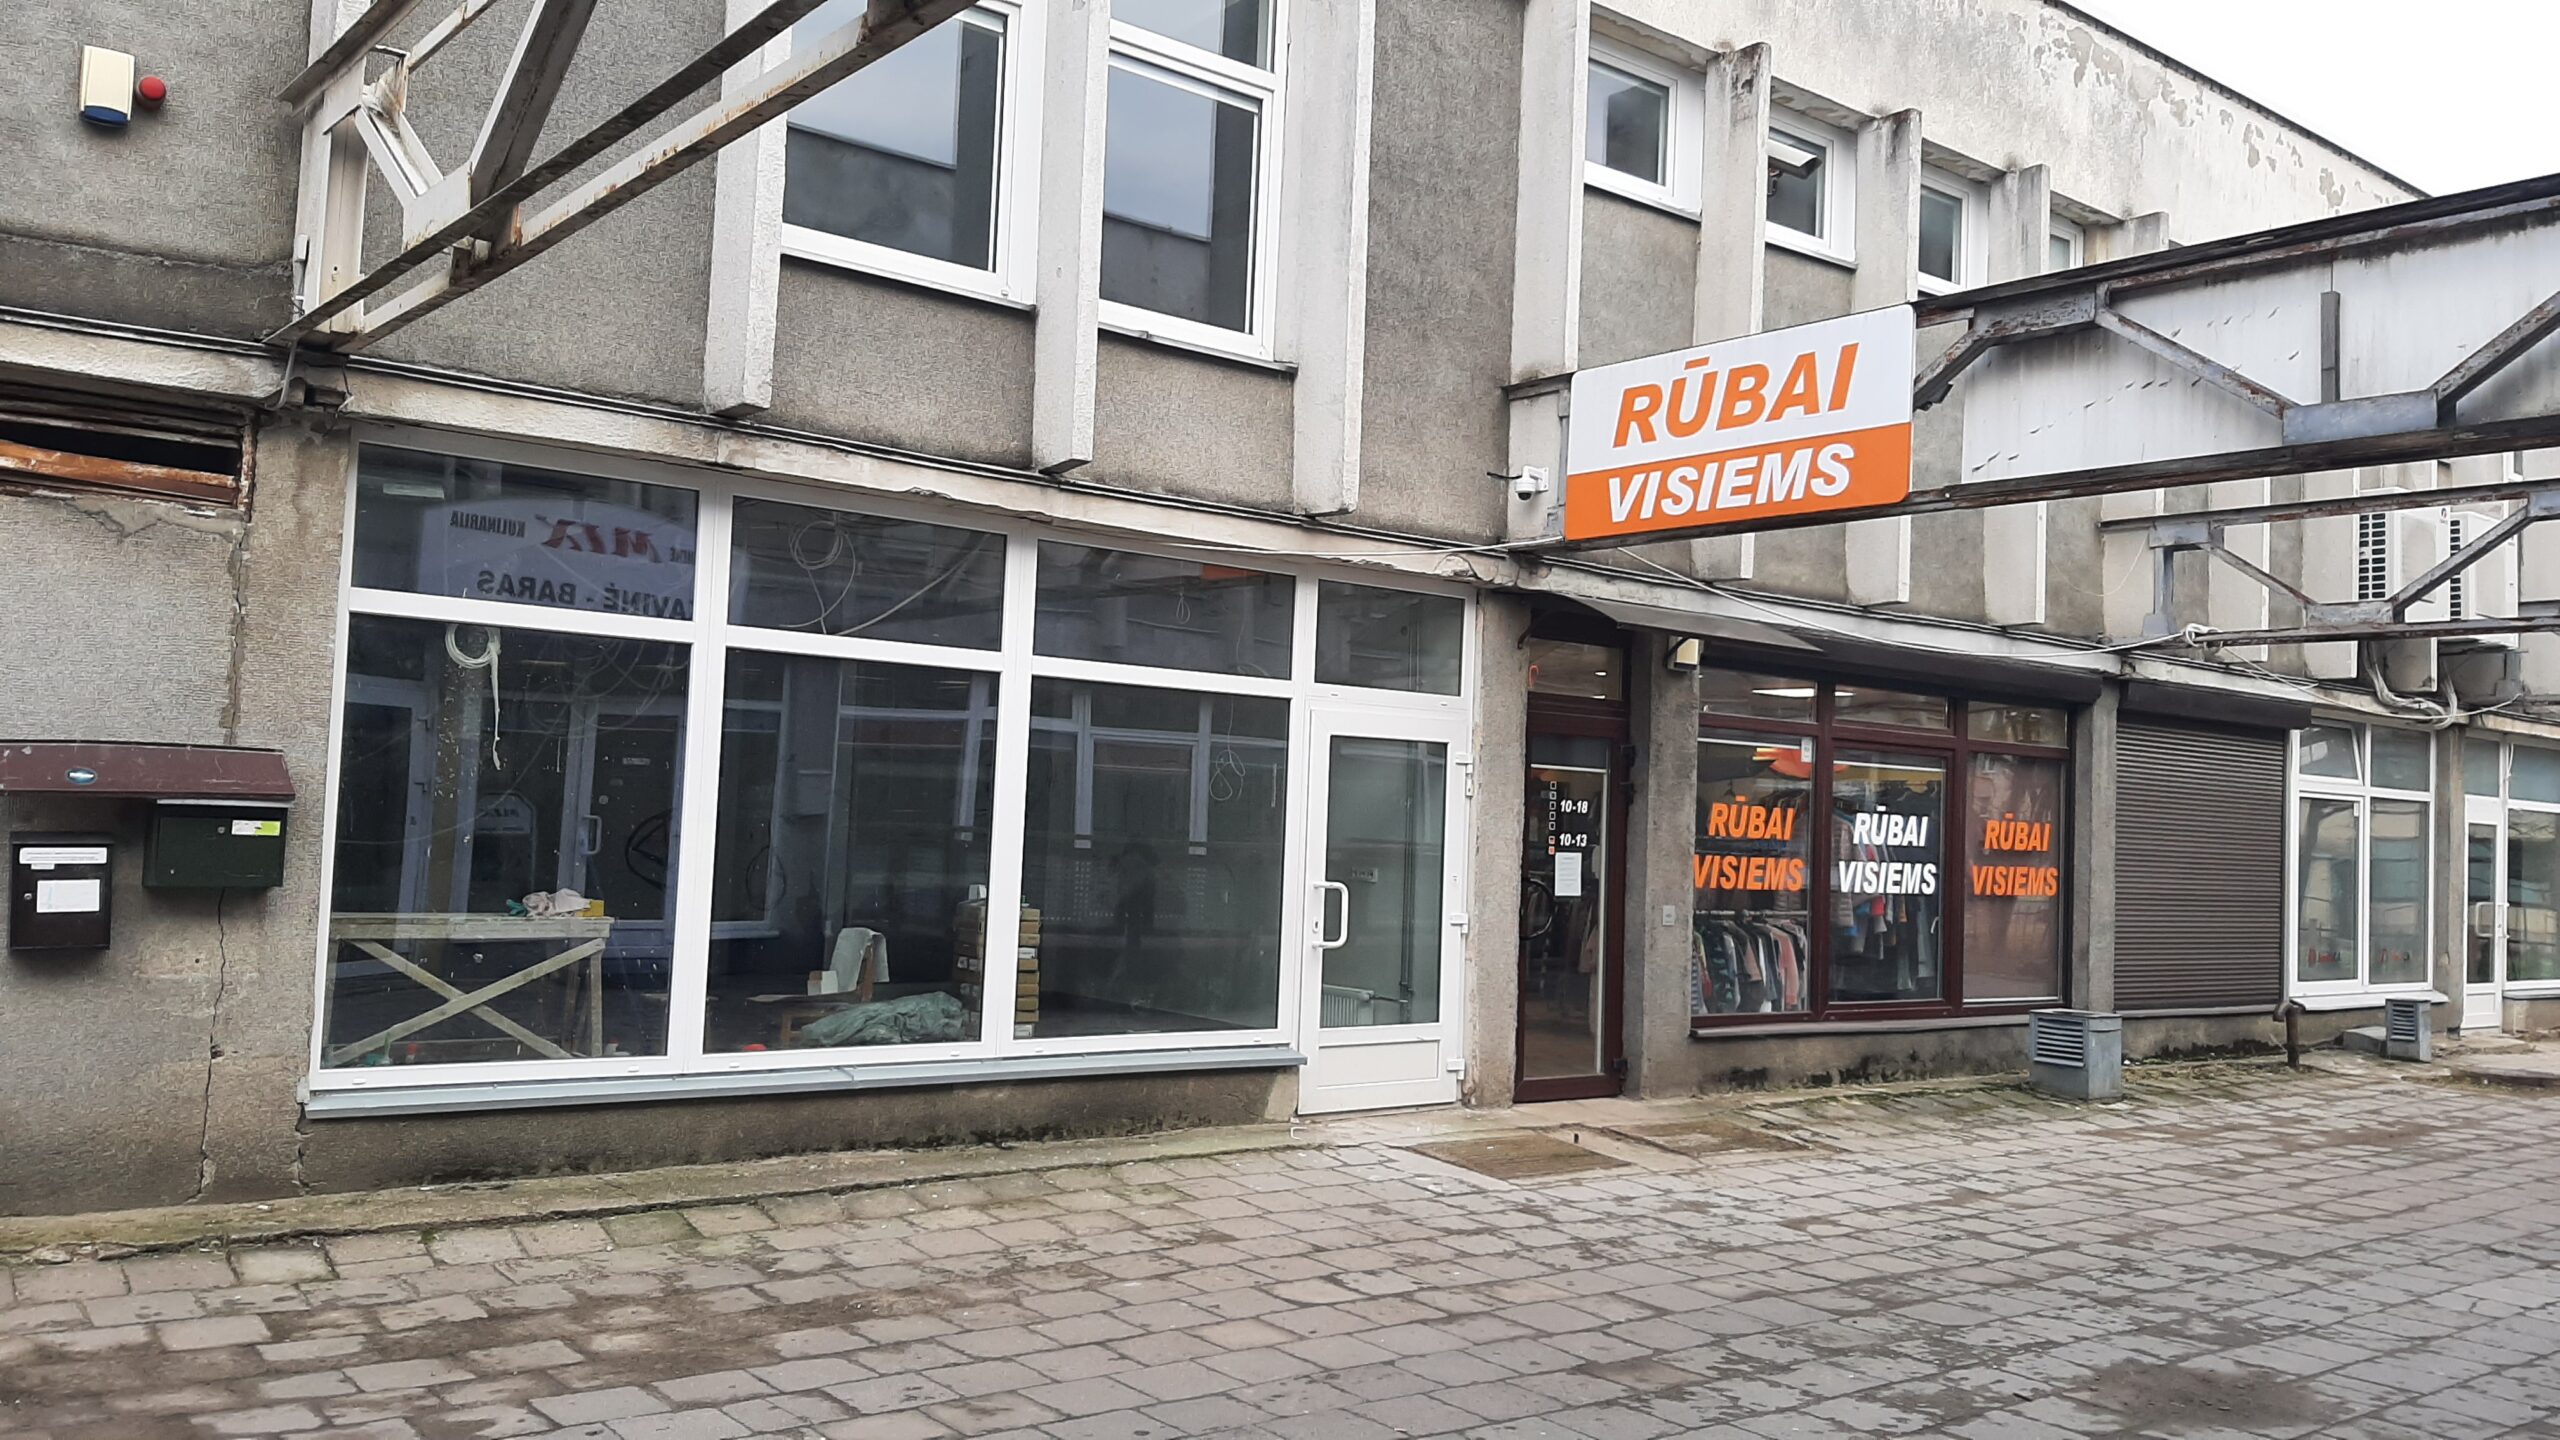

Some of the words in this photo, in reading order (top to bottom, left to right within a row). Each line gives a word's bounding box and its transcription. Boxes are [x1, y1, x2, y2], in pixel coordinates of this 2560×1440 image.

[1613, 343, 1859, 448] RŪBAI
[1608, 443, 1855, 524] VISIEMS
[1560, 800, 1588, 813] 10-18
[1708, 796, 1795, 841] RŪBAI
[1559, 833, 1587, 847] 10-13
[1853, 805, 1928, 847] RŪBAI
[1984, 813, 2052, 852] RŪBAI
[1693, 854, 1805, 892] VISIEMS
[1838, 860, 1937, 895] VISIEMS
[1971, 864, 2059, 896] VISIEMS
